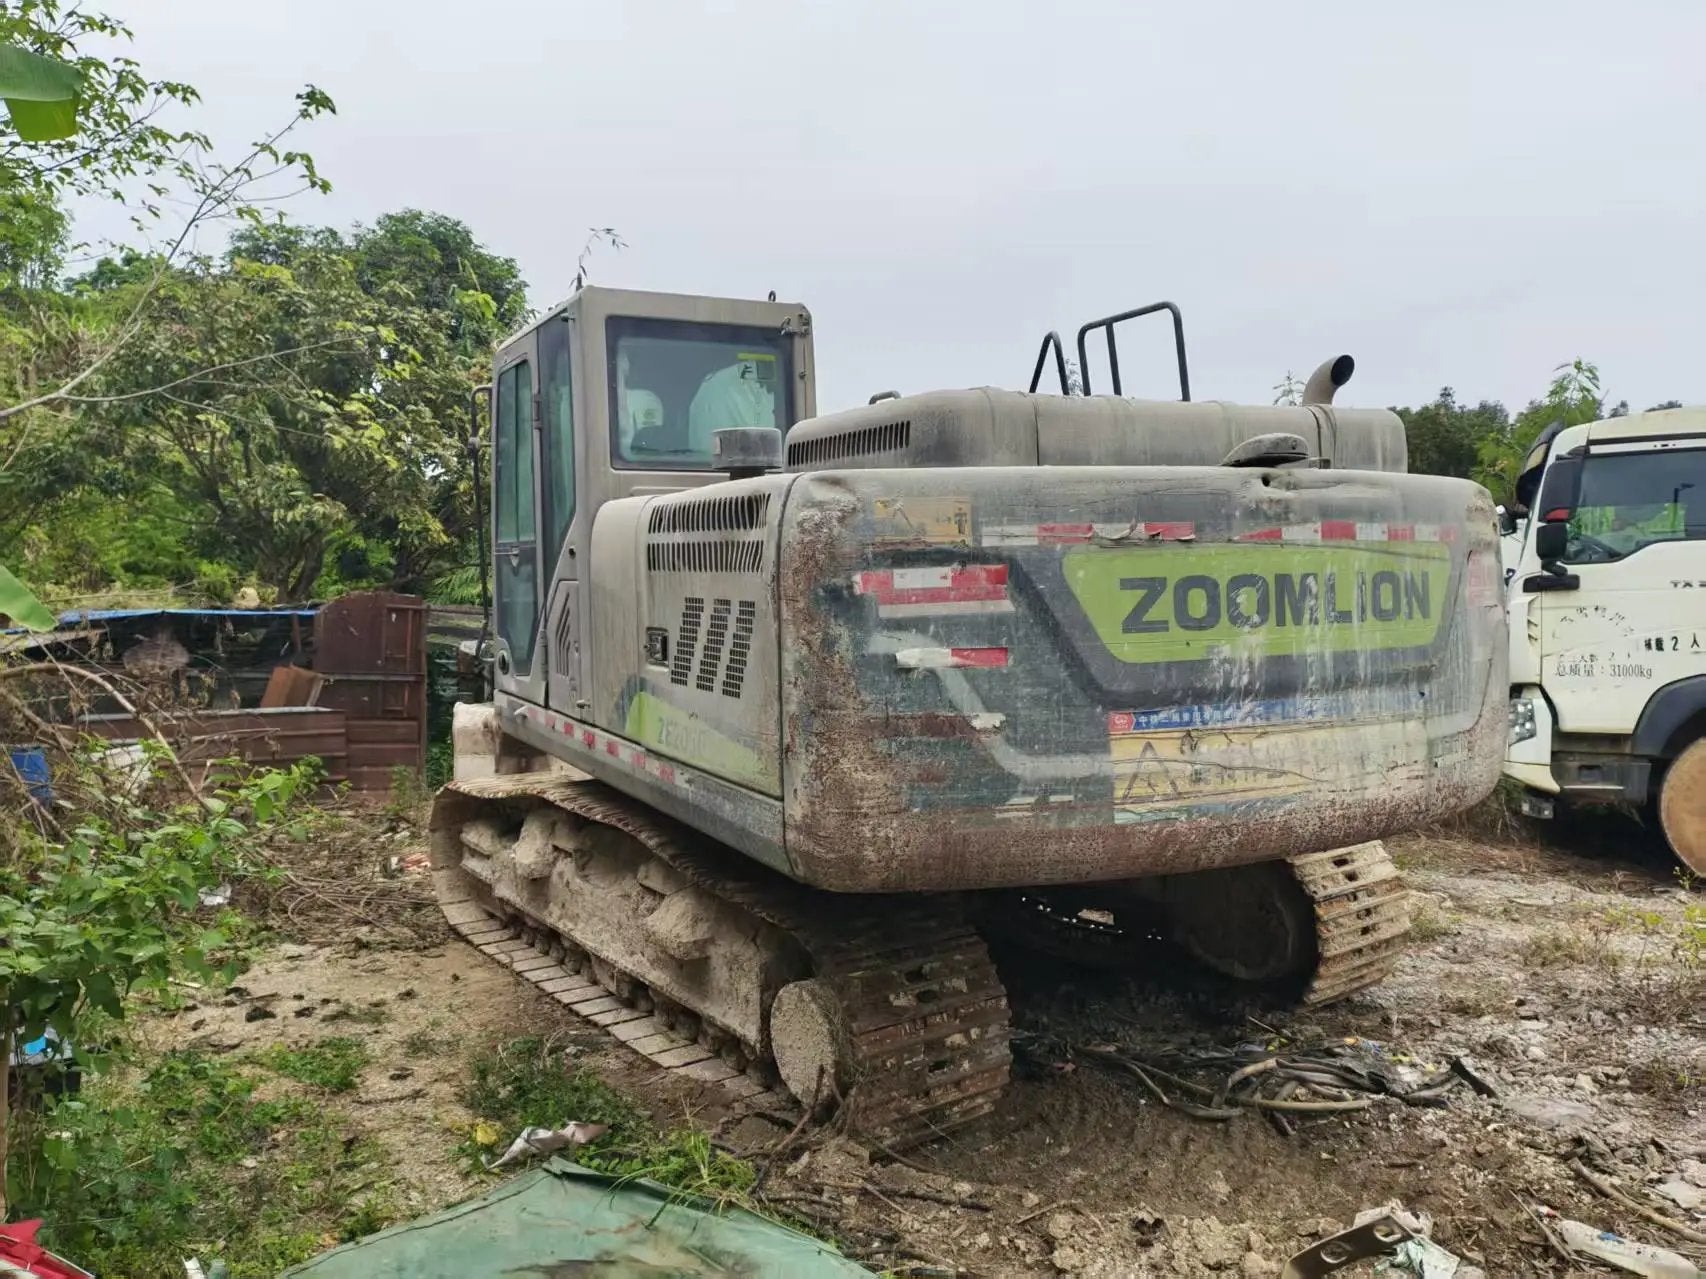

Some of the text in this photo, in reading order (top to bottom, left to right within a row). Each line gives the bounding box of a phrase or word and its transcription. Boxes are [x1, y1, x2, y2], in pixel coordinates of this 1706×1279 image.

[1119, 570, 1430, 634] ZOOMLION
[1671, 636, 1679, 652] 2
[1690, 632, 1701, 648] 人
